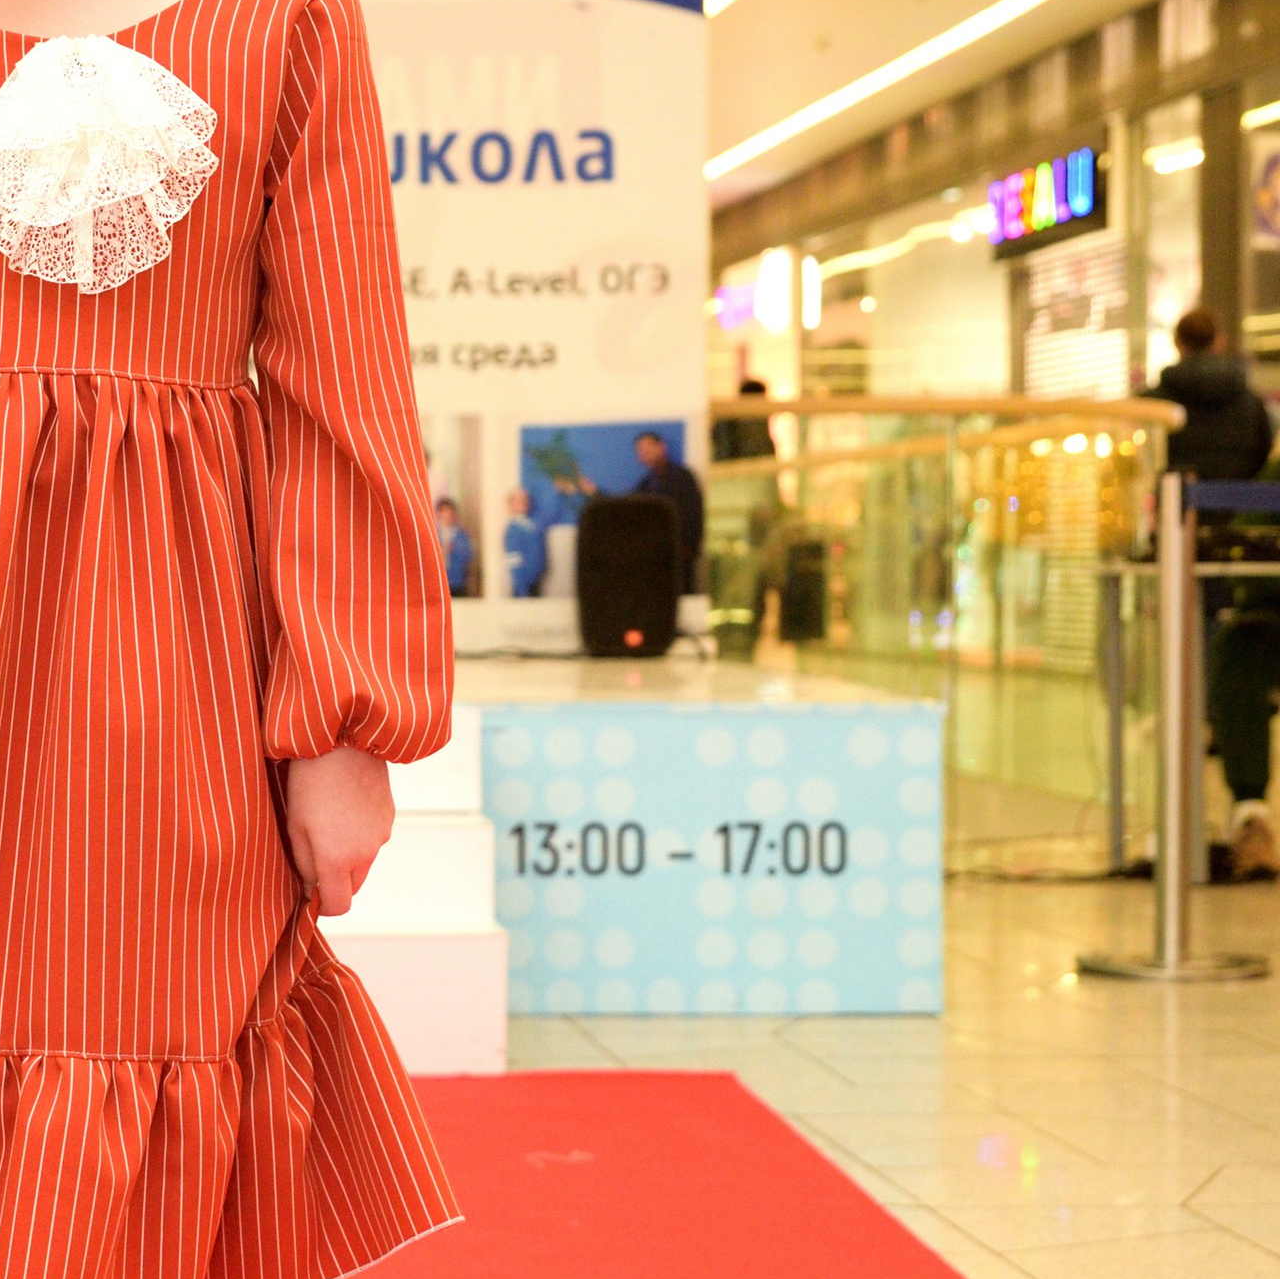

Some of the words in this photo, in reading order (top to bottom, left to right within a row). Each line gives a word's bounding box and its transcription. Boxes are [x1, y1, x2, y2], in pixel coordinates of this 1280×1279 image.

[450, 340, 558, 371] среда
[509, 820, 646, 878] 13:00
[714, 819, 849, 878] 17:00
